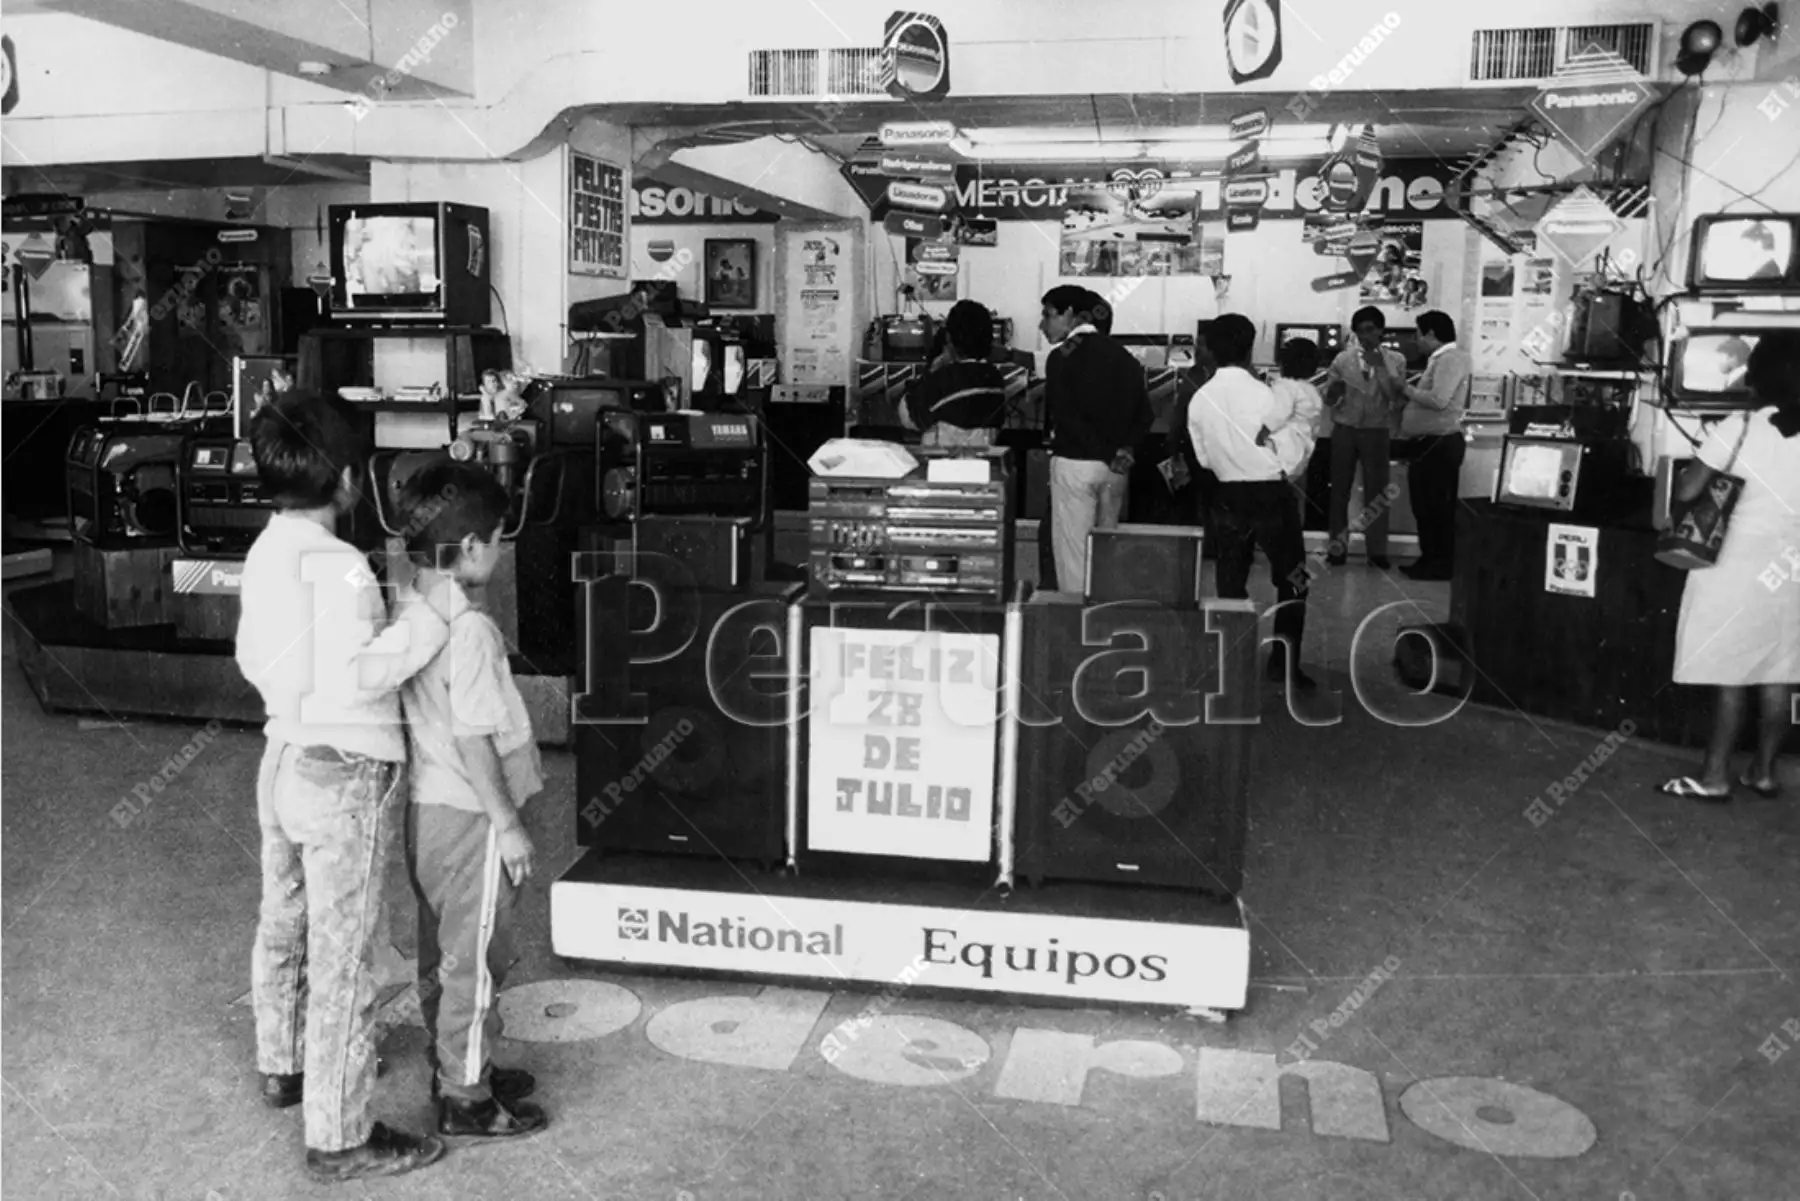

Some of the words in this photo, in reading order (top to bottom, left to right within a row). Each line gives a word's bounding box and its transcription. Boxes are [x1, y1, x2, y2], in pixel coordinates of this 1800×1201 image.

[884, 128, 951, 139] Panasonic
[631, 187, 757, 217] sonic
[839, 643, 974, 683] FELIZ
[867, 690, 923, 726] 28
[863, 734, 920, 771] DE
[836, 777, 971, 821] JULIO
[657, 911, 843, 956] National
[922, 928, 1168, 984] Equipos
[240, 978, 1598, 1159] oderno
